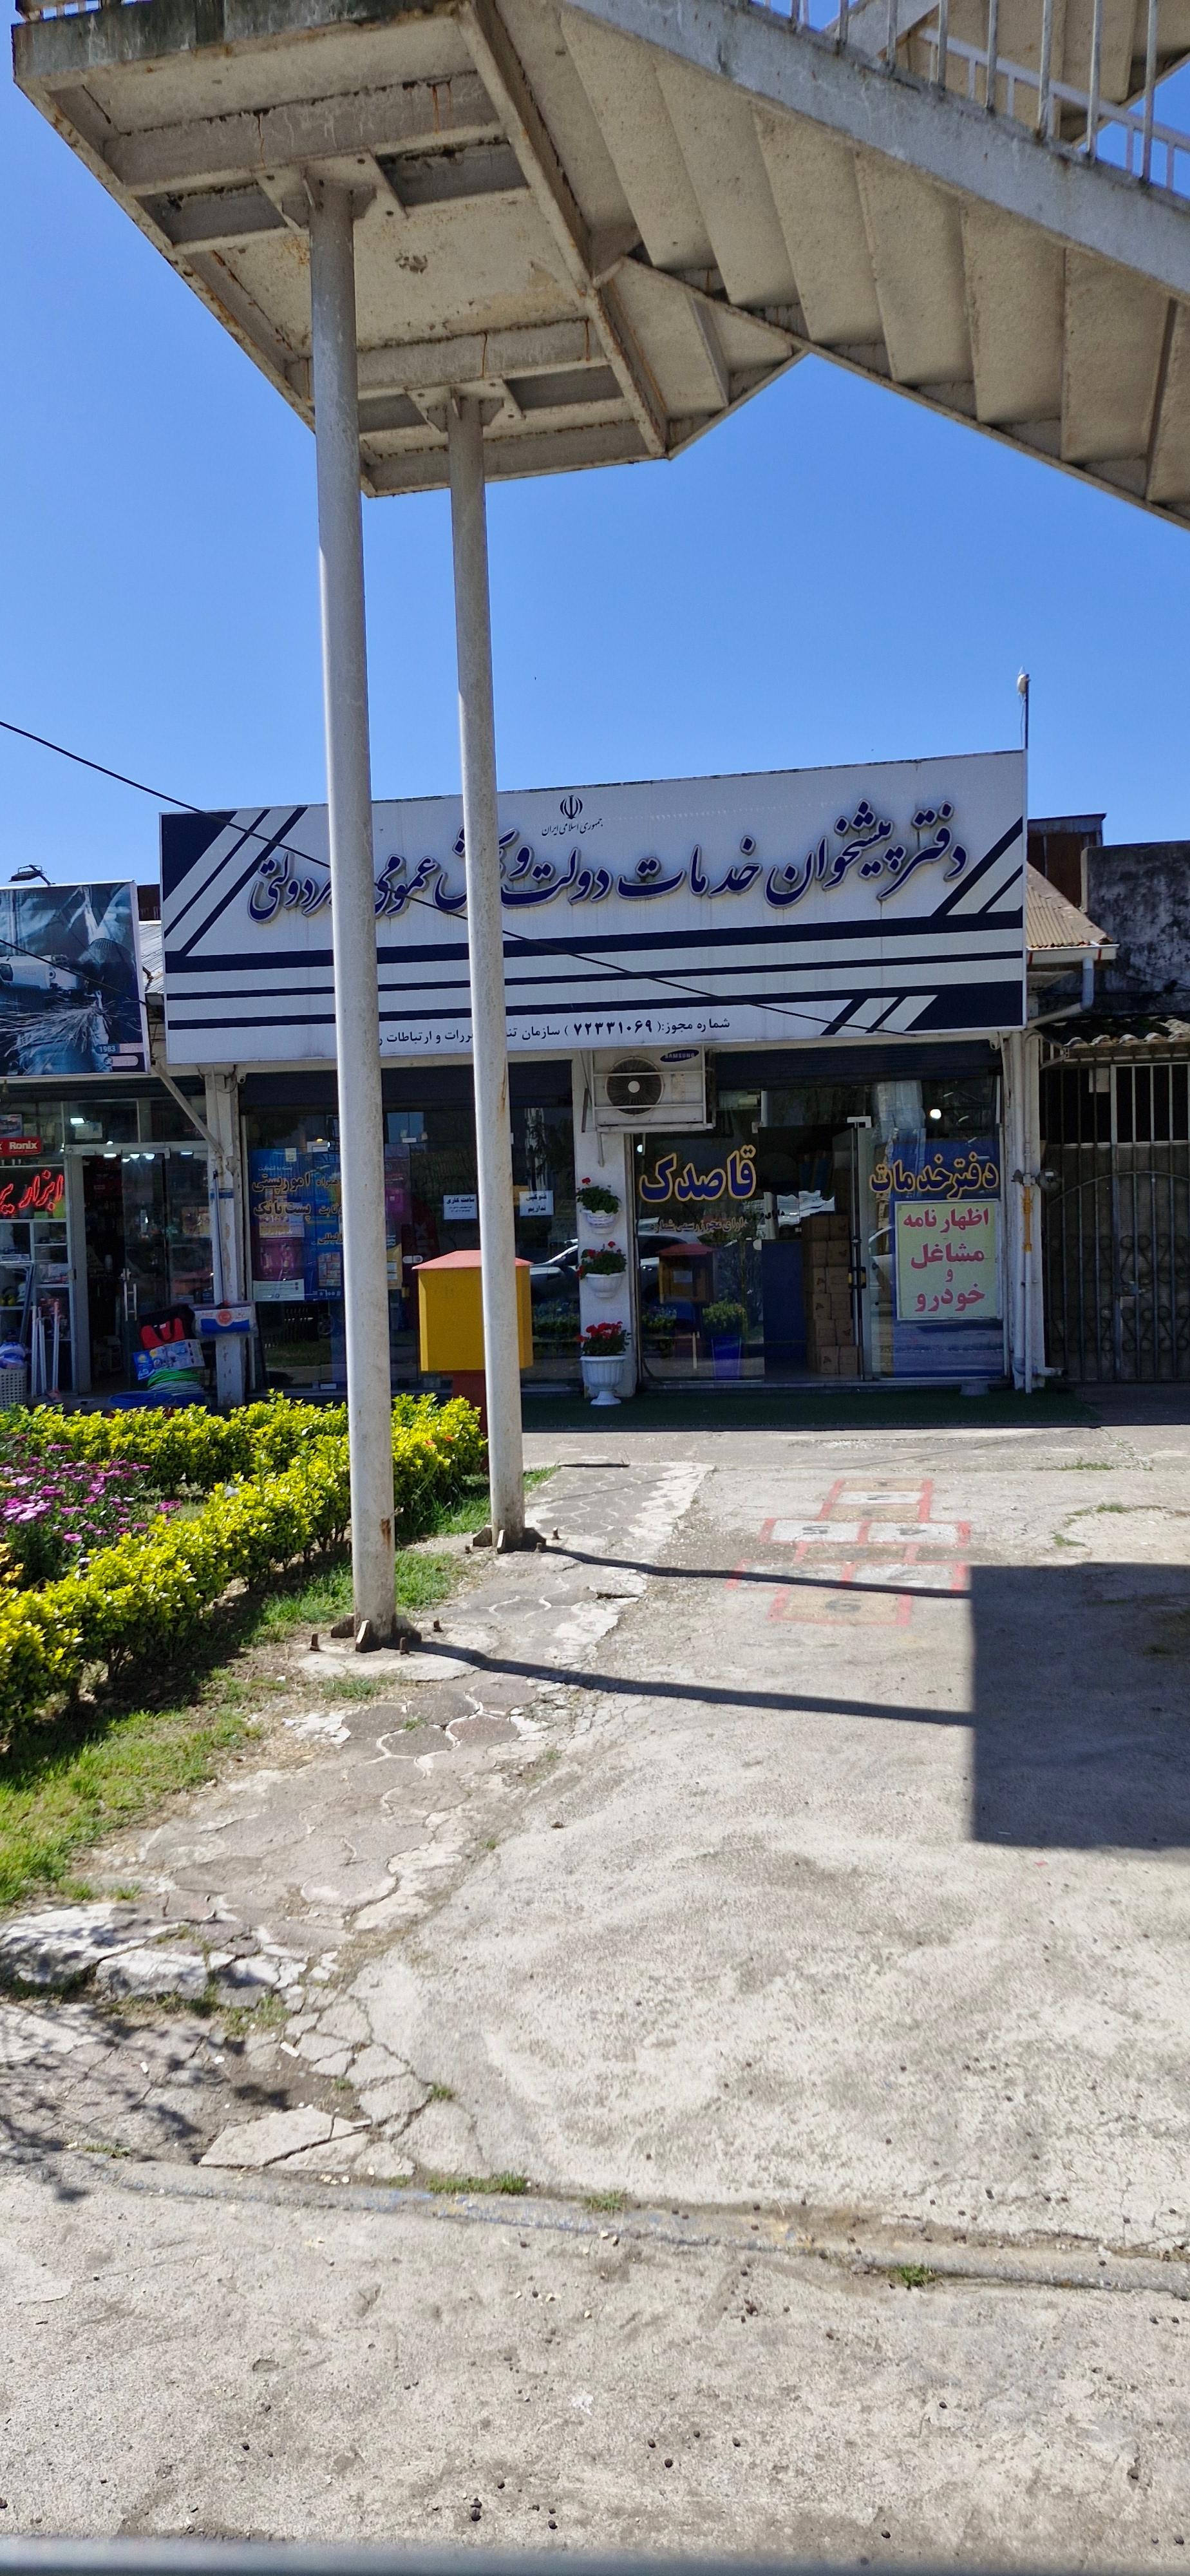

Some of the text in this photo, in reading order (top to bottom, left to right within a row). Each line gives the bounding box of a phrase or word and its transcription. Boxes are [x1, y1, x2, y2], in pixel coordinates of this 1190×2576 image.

[542, 818, 603, 836] جمهوری اسلامی ایران
[507, 844, 535, 881] و
[764, 798, 906, 909] پیشخوان
[877, 800, 968, 902] دفتر
[501, 846, 614, 909] دولت
[617, 835, 762, 902] خدمات
[386, 1030, 432, 1045] ارتباطات
[444, 1029, 474, 1042] ررات
[522, 1025, 560, 1041] سازمان
[696, 1018, 730, 1032] شماره
[435, 1034, 441, 1044] و
[9, 1140, 37, 1150] Ronix
[282, 1172, 311, 1191] امور
[639, 1144, 757, 1203] قاصدک
[871, 1151, 999, 1200] دفتر خدمات
[19, 1169, 64, 1212] ابزار
[253, 1200, 312, 1222] پست بانک
[903, 1207, 989, 1233] اظهار نامه
[911, 1242, 985, 1269] مشاغل
[945, 1268, 954, 1283] و
[914, 1283, 986, 1312] خودرو
